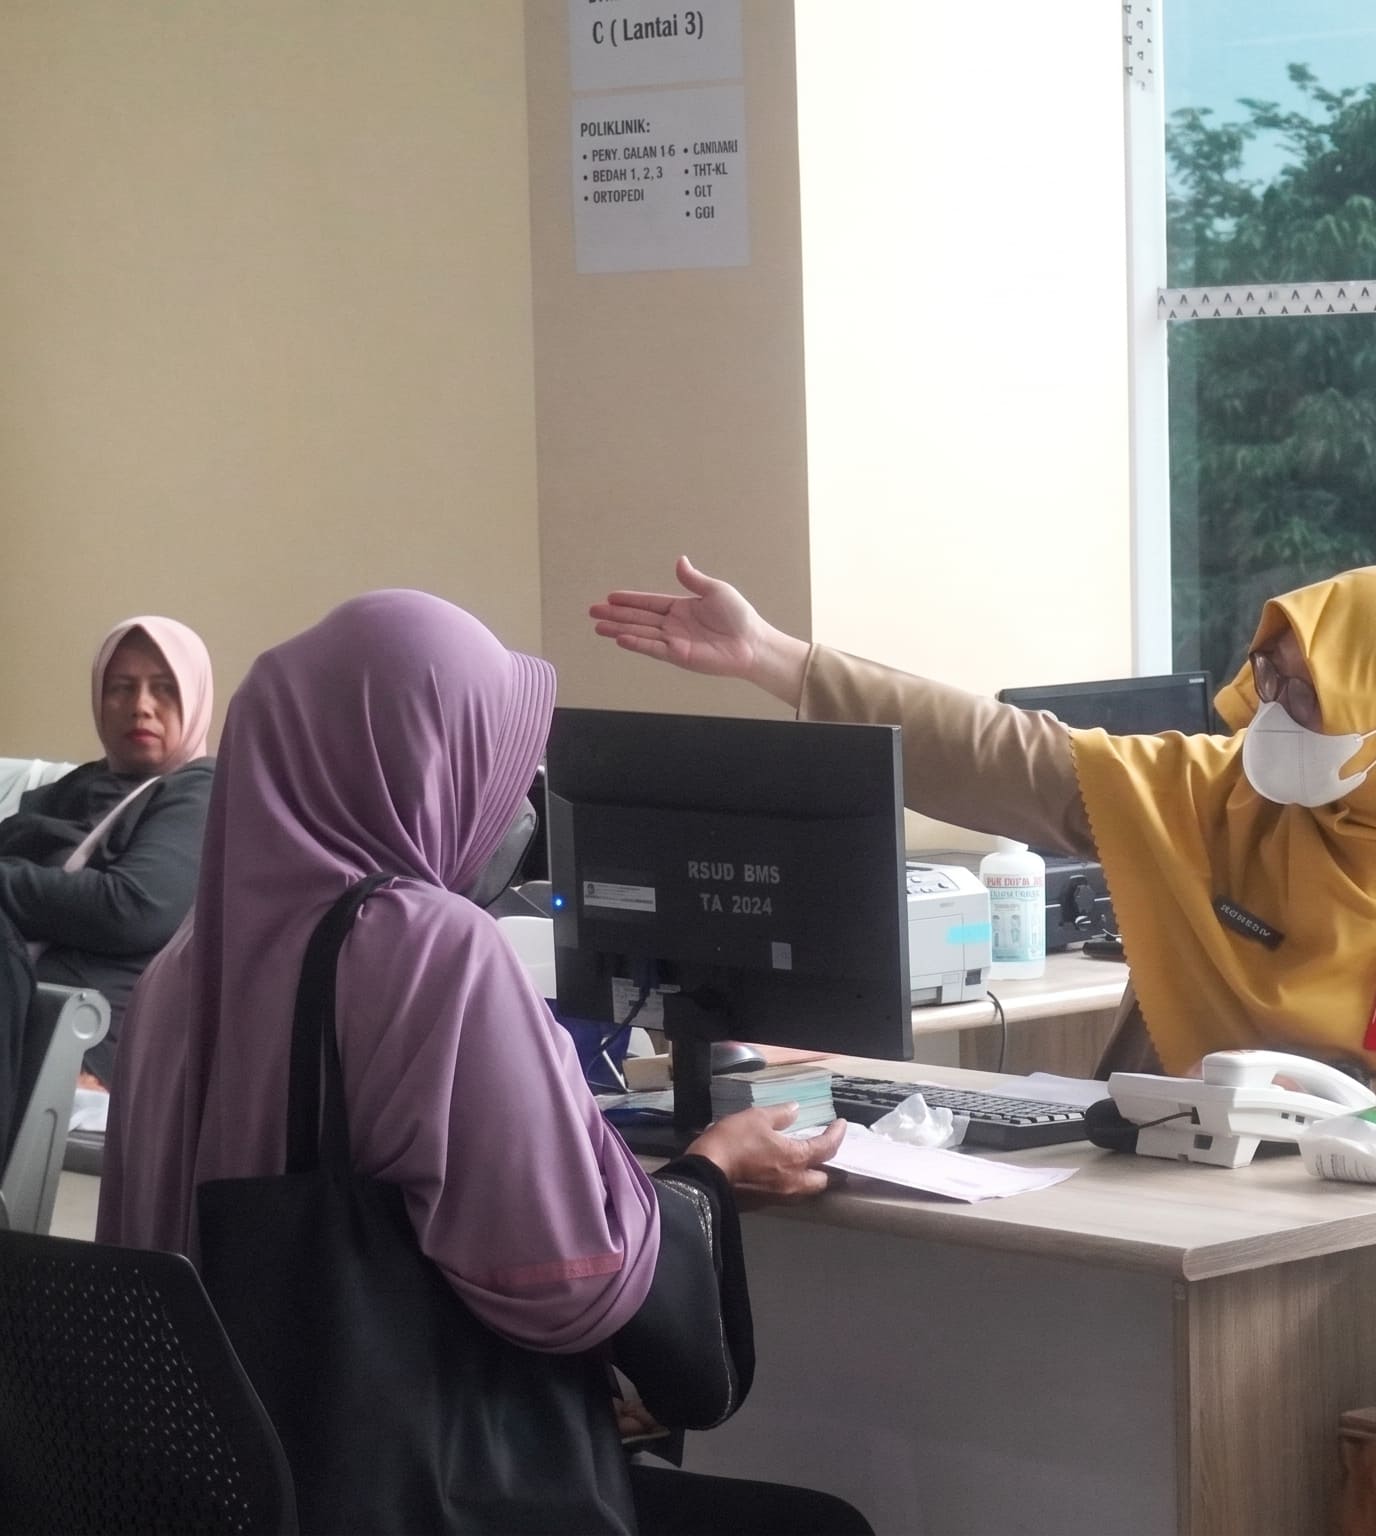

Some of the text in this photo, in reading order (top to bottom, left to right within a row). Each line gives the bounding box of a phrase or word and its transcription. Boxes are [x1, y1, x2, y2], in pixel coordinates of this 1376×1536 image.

[592, 20, 604, 44] C
[622, 13, 678, 41] Lantai
[684, 10, 704, 40] 3)
[580, 118, 650, 138] POLIKLINIK:
[592, 168, 627, 183] BEDAH
[592, 188, 645, 204] ORTOPEDI
[687, 860, 780, 884] RSUD BMS
[699, 893, 773, 916] TA 2024
